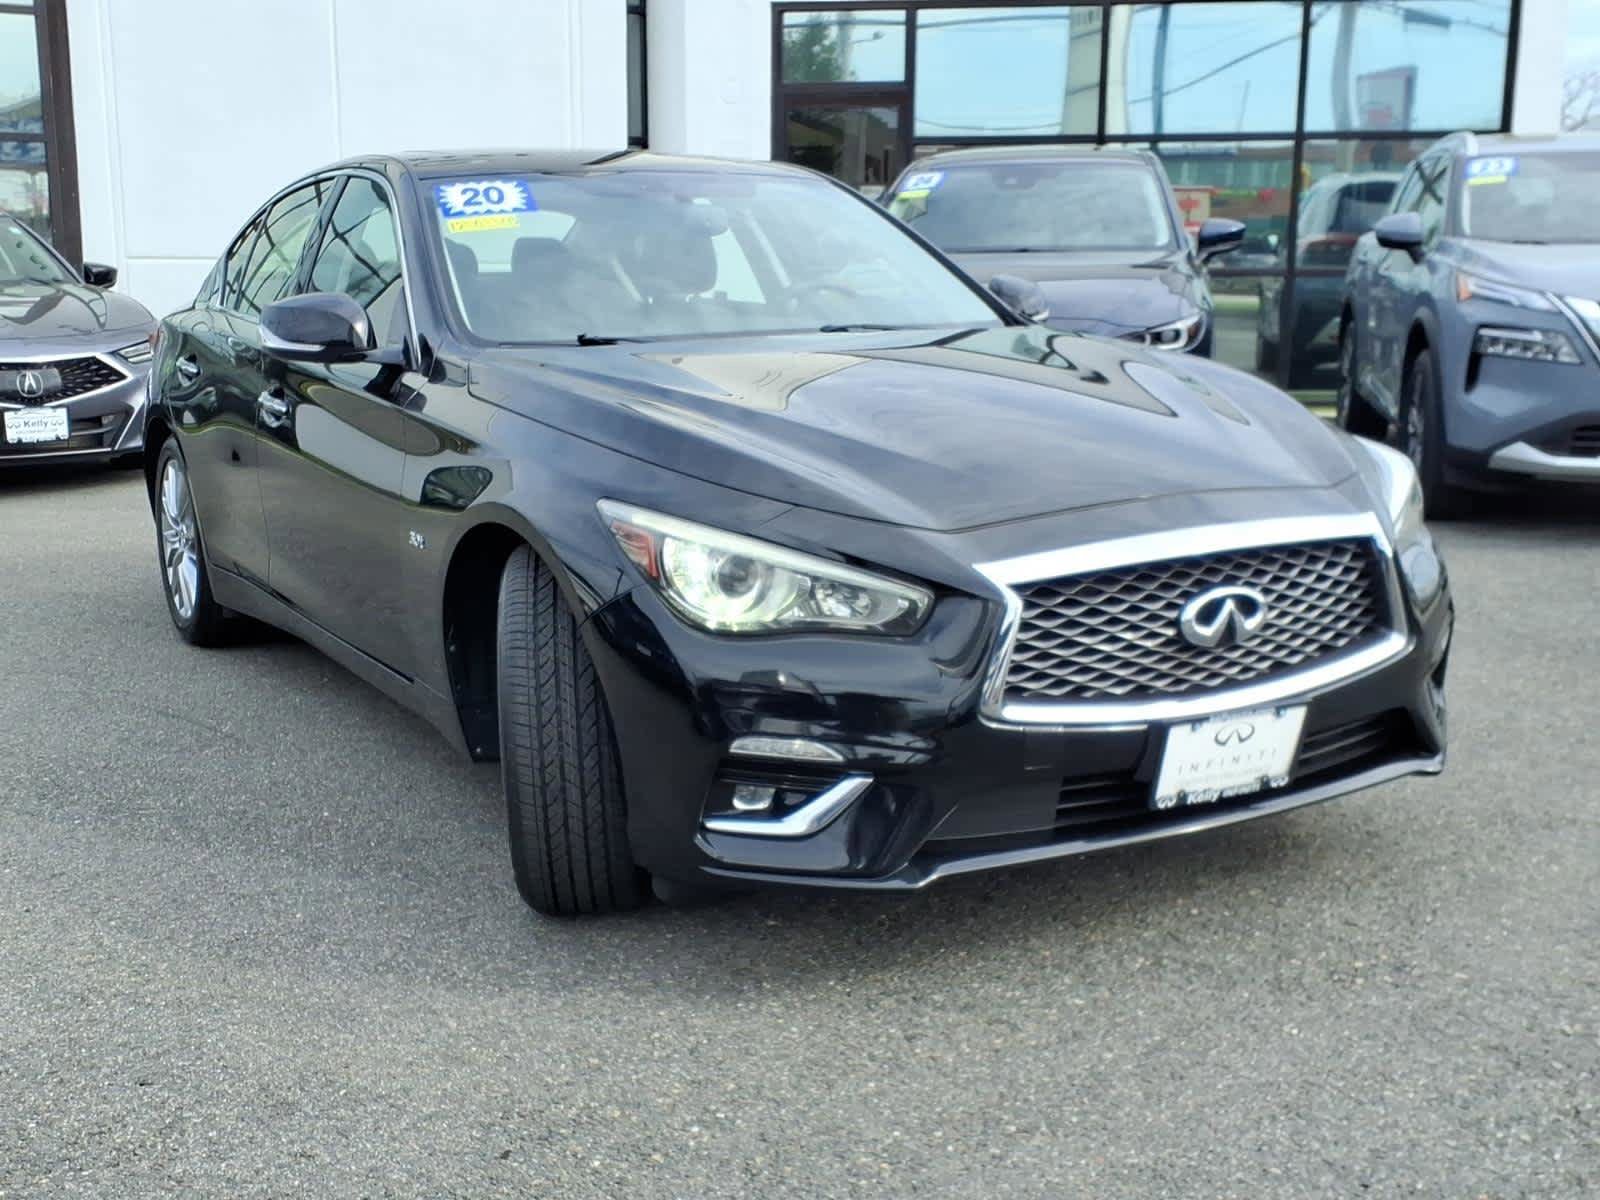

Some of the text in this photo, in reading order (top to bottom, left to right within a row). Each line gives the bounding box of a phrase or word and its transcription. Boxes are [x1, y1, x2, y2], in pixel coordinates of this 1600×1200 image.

[460, 186, 505, 207] 20
[23, 419, 49, 429] Kelly
[1178, 748, 1277, 775] INFINITI
